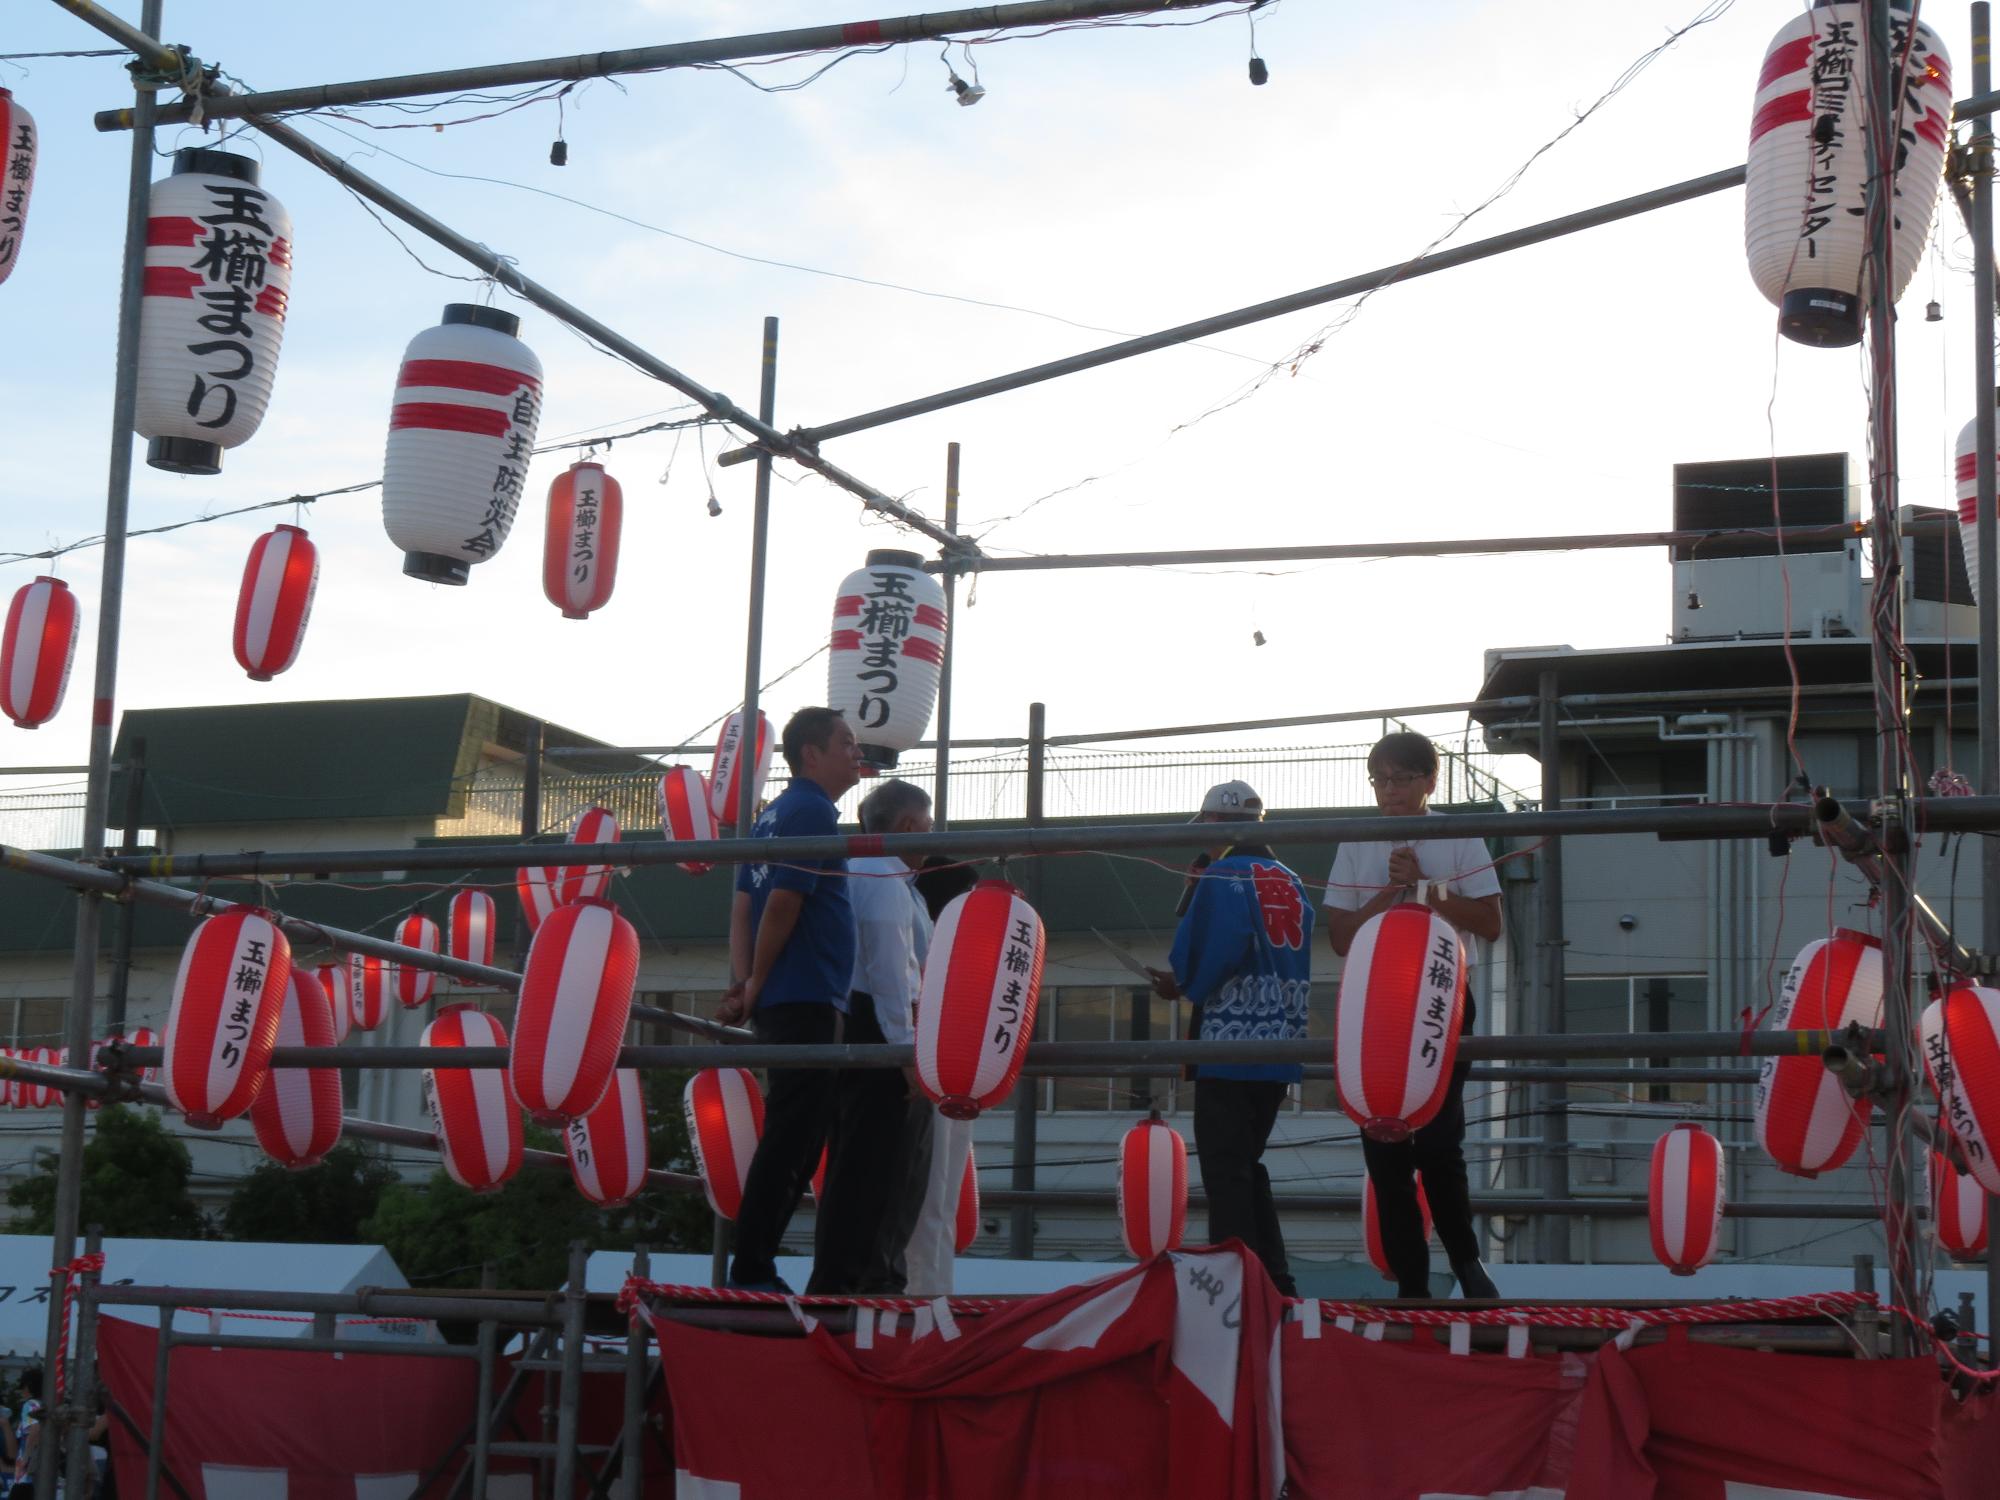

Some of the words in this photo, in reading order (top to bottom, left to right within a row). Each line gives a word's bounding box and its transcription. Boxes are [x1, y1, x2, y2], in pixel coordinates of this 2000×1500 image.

[187, 184, 273, 430] 玉櫛まつり
[462, 391, 534, 558] 自主防災会
[574, 489, 599, 585] 玉櫛まつり
[857, 572, 915, 728] 玉櫛まつり
[221, 940, 268, 1069] 玉櫛まつり
[995, 919, 1033, 1055] 玉櫛まつり
[1421, 936, 1456, 1068] 玉櫛まつり
